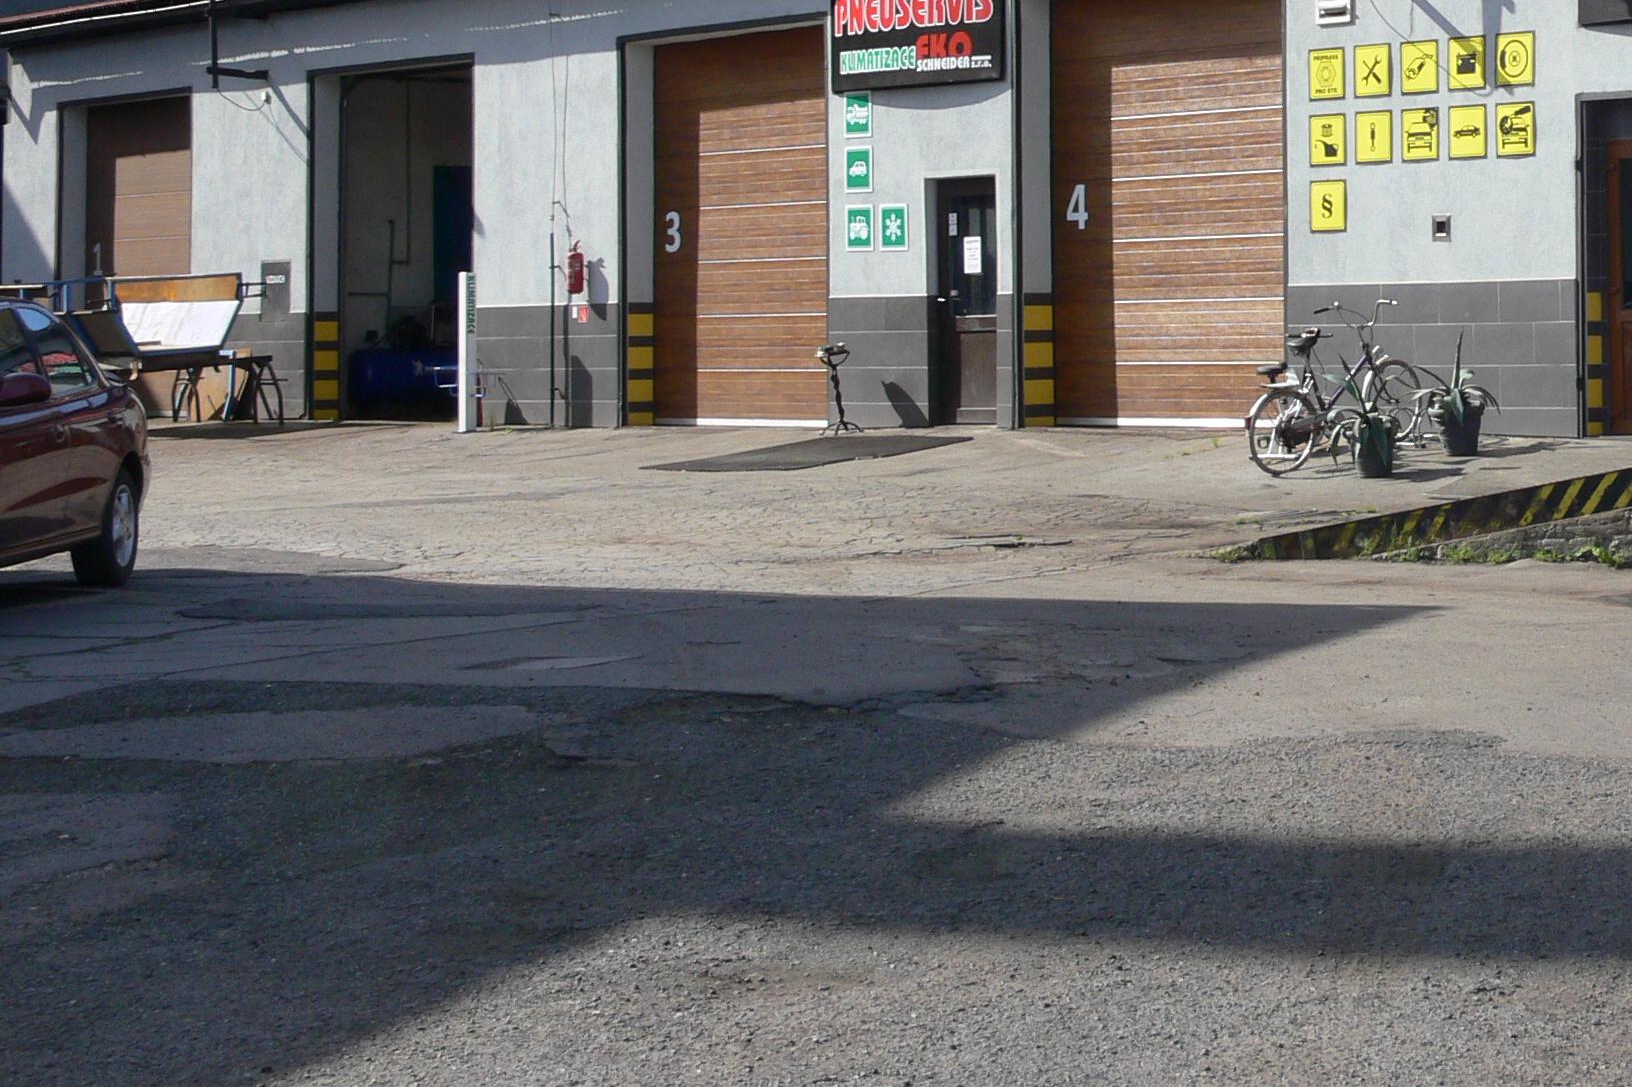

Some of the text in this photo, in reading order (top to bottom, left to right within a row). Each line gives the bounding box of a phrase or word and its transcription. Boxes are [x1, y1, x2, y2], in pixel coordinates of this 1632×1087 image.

[839, 45, 917, 75] KLIMATIZACE
[915, 29, 973, 59] EKO
[916, 56, 970, 72] SCHNEIDER
[1066, 184, 1089, 230] 4
[665, 211, 681, 253] 3
[93, 242, 104, 276] 1
[467, 275, 476, 334] KLIMATIZACE
